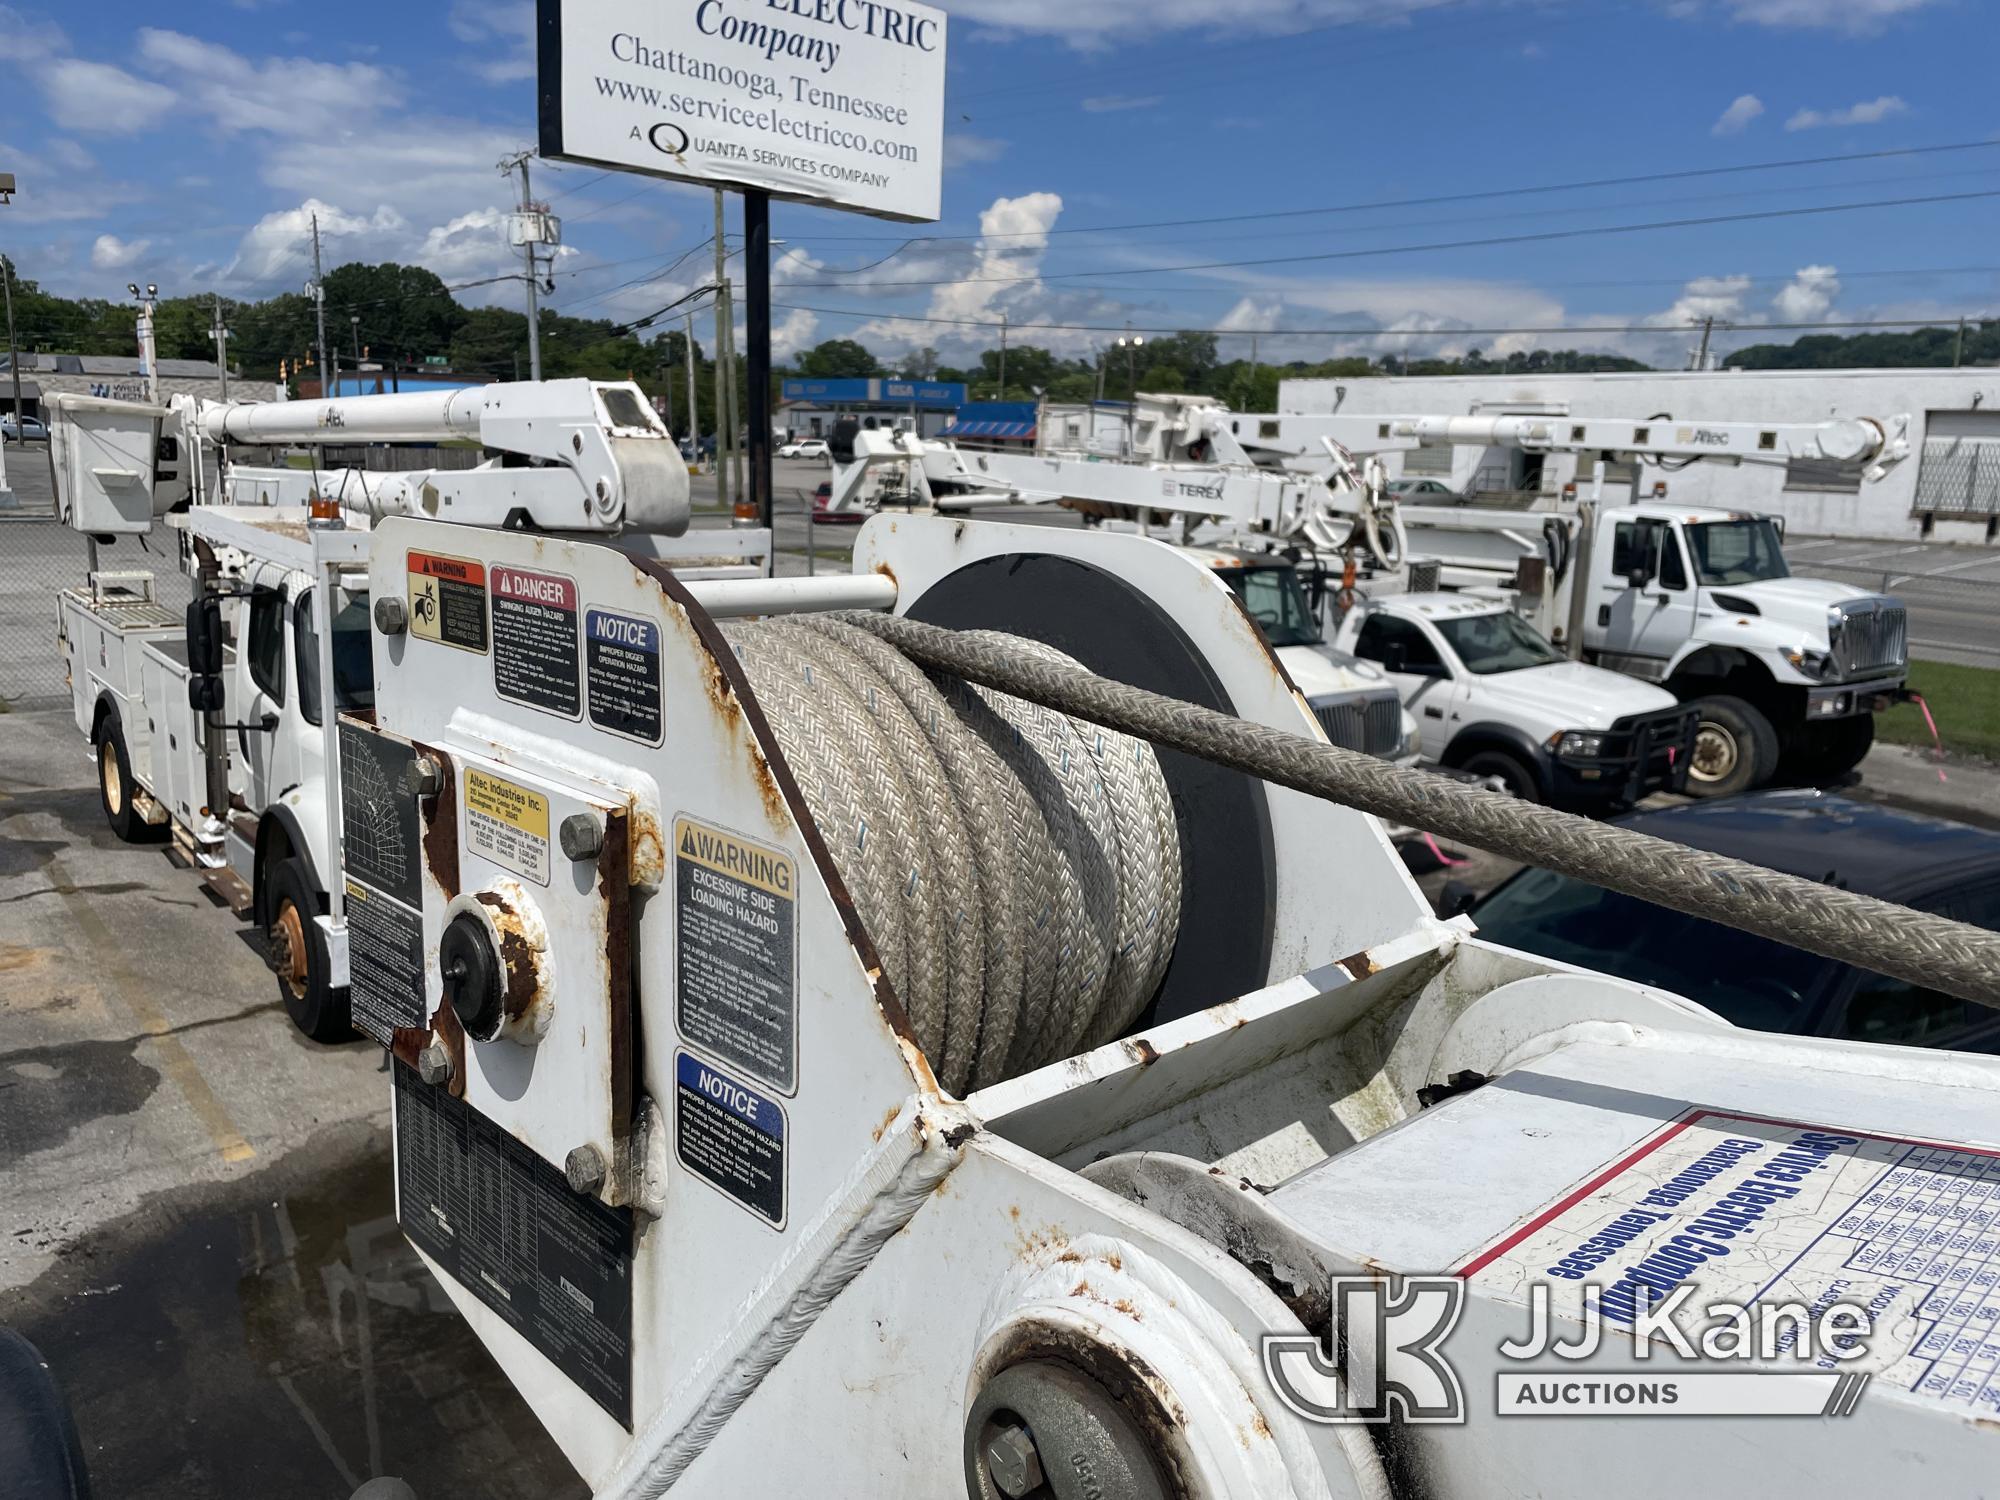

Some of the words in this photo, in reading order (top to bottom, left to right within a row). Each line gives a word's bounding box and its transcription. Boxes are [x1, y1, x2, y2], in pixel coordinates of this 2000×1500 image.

[695, 0, 841, 73] Company
[611, 32, 783, 100] Chattanooga,
[789, 75, 908, 126] Tennessee
[595, 75, 920, 163] www.serviceelectricco.com
[629, 125, 642, 141] A
[752, 147, 817, 175] SERVICES
[820, 162, 890, 189] COMPANY
[1179, 483, 1224, 501] TEREX
[431, 560, 467, 579] WARNING
[514, 575, 564, 604] DANGER
[543, 607, 565, 622] HAZARD
[596, 616, 648, 647] NOTICE
[598, 655, 626, 670] OPERATION
[626, 662, 648, 674] HAZARD
[599, 645, 625, 658] IMPROPER
[625, 651, 645, 663] DIGGER
[469, 773, 488, 791] Altec
[490, 780, 526, 805] Industries
[528, 795, 542, 812] Inc.
[697, 832, 789, 892] WARNING
[691, 886, 734, 916] LOADING
[736, 905, 778, 935] HAZARD
[693, 868, 748, 903] EXCESSIVE
[750, 891, 776, 915] SIDE
[699, 1069, 759, 1121] NOTICE
[679, 1085, 706, 1107] IMPROPER
[706, 1101, 724, 1118] BOOM
[724, 1112, 756, 1138] OPERATION
[756, 1131, 782, 1153] HAZARD
[1636, 1138, 1764, 1208] Chattanooga,
[1754, 1132, 1859, 1183] Service
[1685, 1179, 1802, 1241] Electric
[1547, 1208, 1674, 1281] Tennessee
[1879, 1222, 1906, 1238] 3440
[1854, 1247, 1882, 1264] 2784
[1877, 1251, 1905, 1269] 2442
[1900, 1256, 1929, 1273] 2124
[1583, 1233, 1730, 1324] Company
[1815, 1278, 1853, 1304] CLASS
[1865, 1284, 1902, 1310] WOOD
[1922, 1373, 1950, 1391] 700
